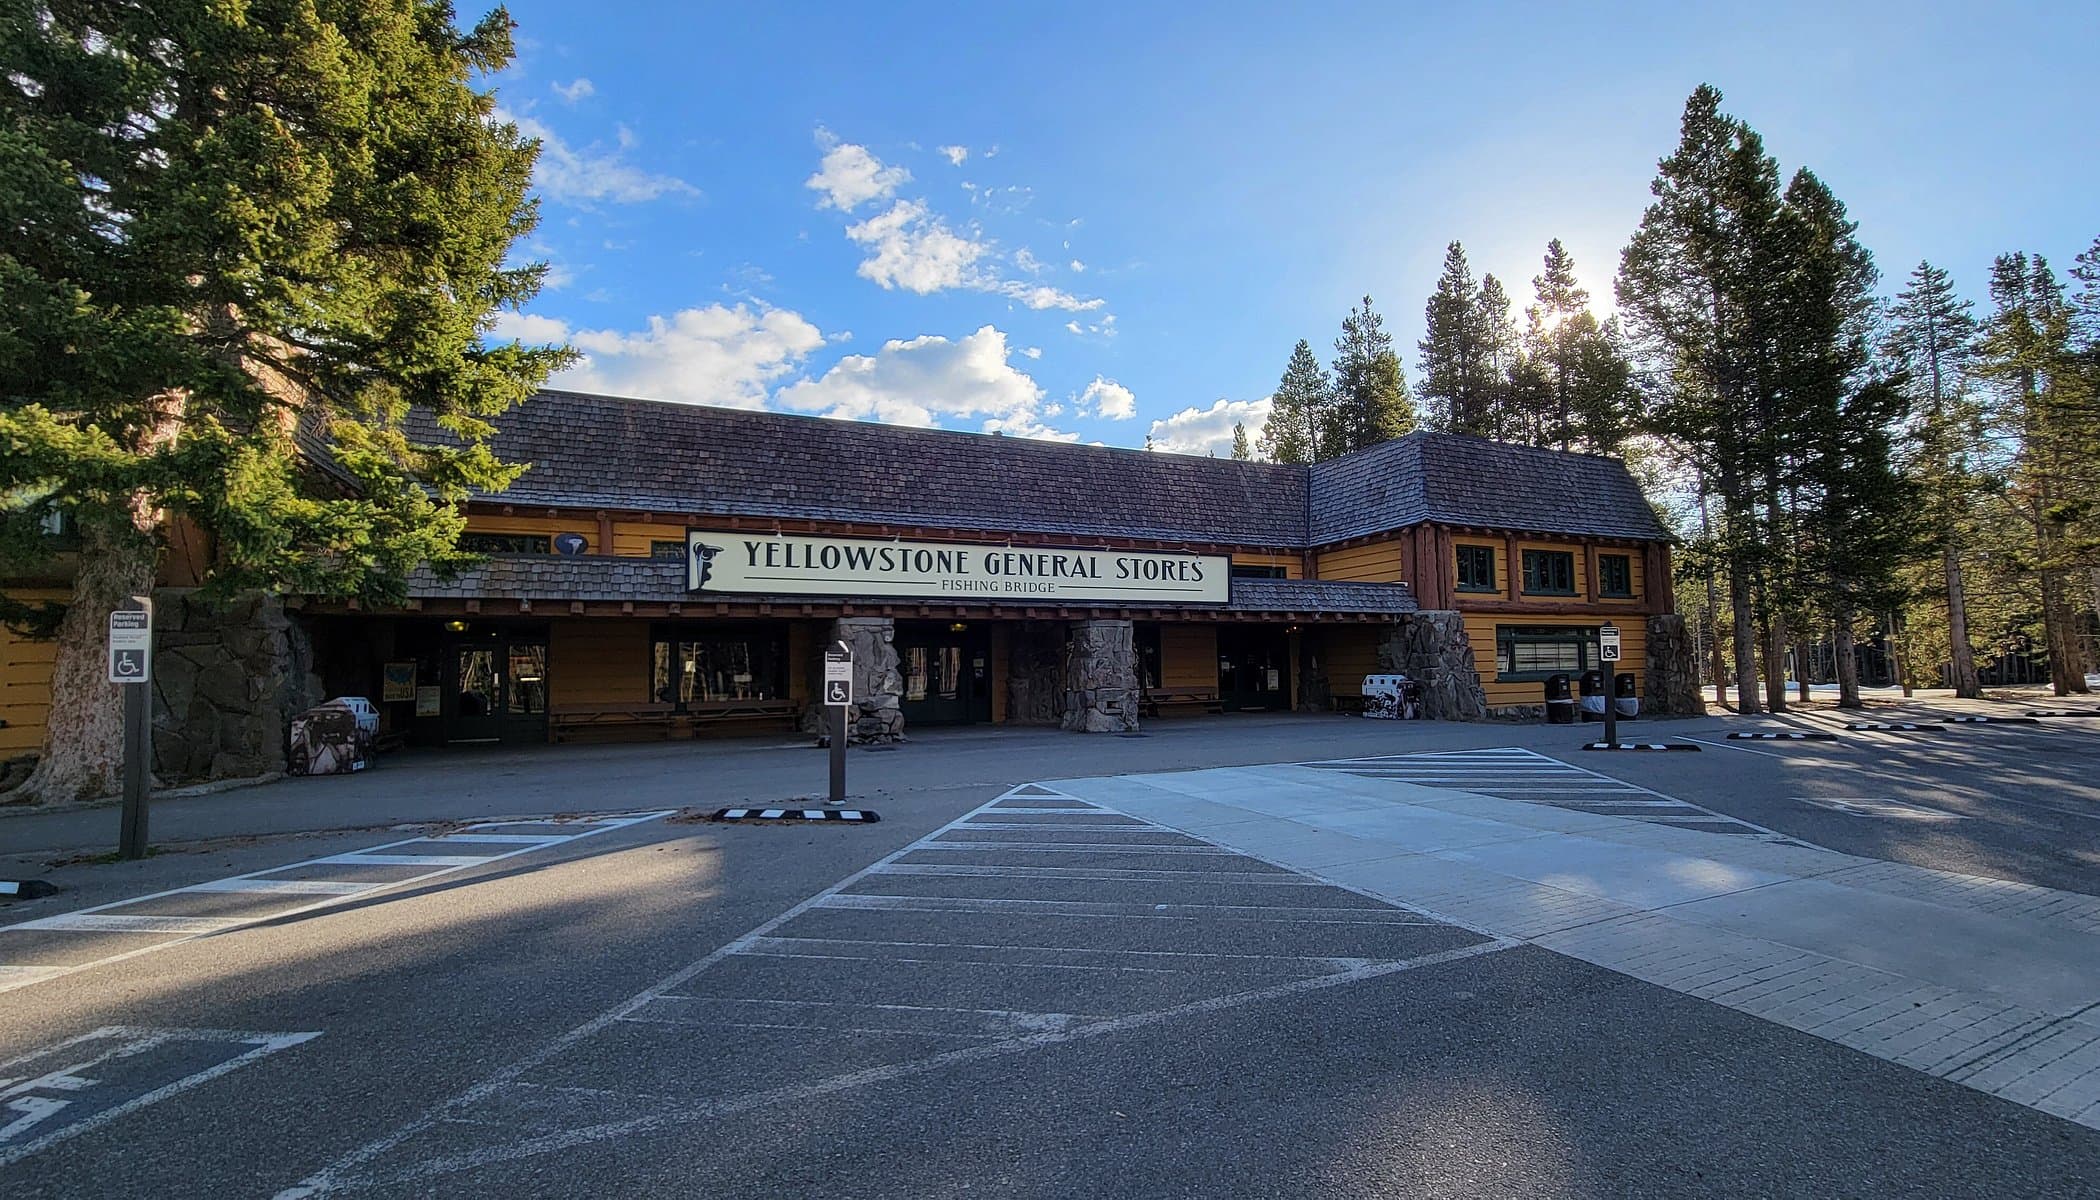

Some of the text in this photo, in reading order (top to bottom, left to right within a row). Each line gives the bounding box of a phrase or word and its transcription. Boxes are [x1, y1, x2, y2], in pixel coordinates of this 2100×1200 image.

[743, 541, 1204, 582] YELLOWSTONE GENERAL STORES
[941, 579, 1056, 593] FISHING BRIDGE
